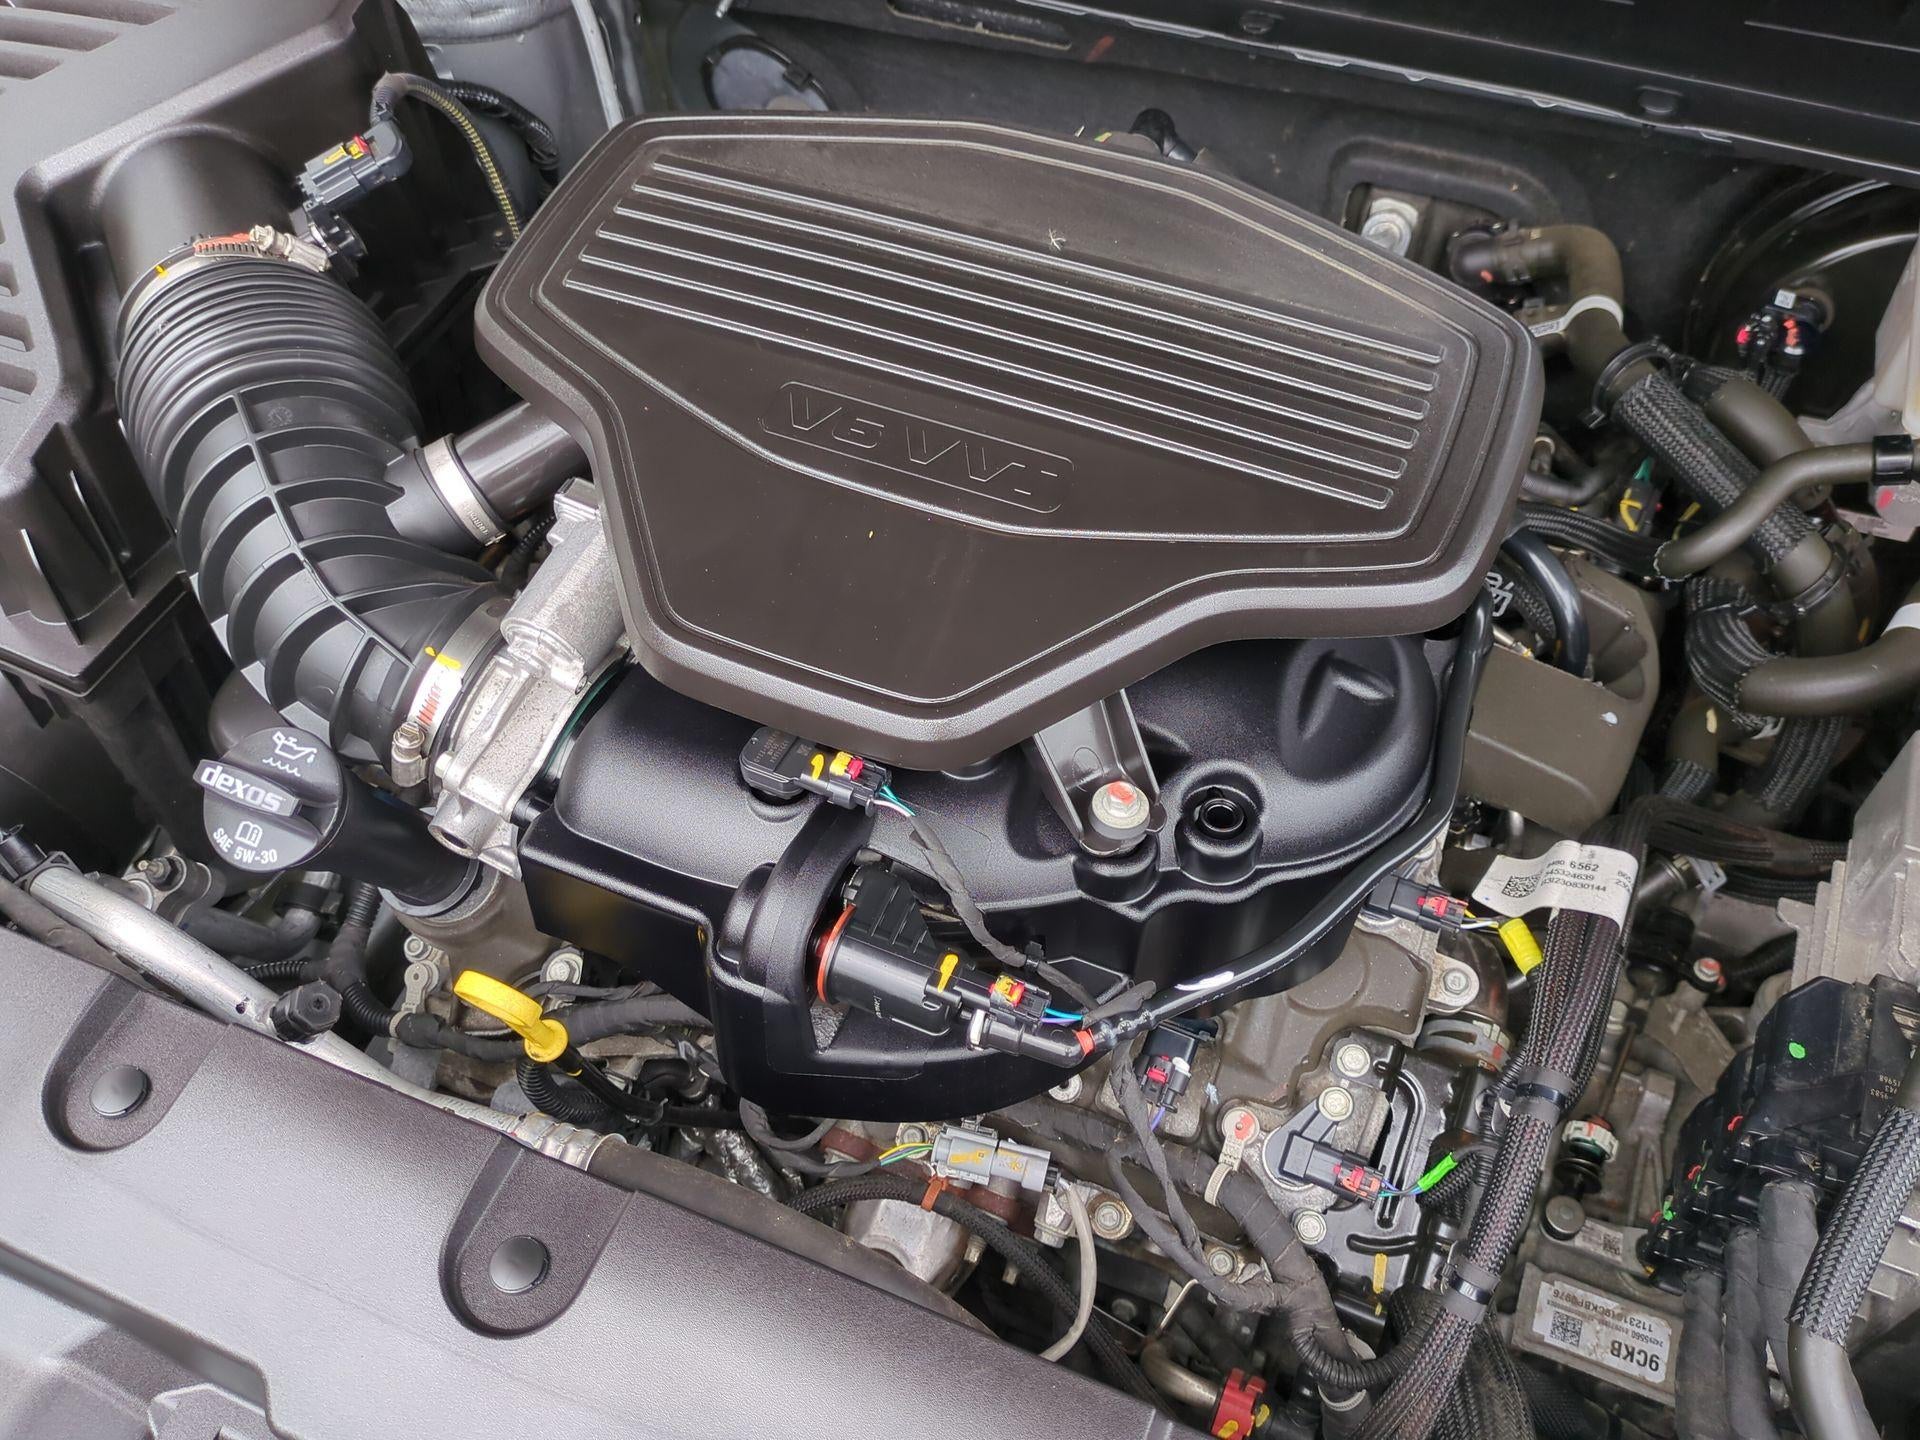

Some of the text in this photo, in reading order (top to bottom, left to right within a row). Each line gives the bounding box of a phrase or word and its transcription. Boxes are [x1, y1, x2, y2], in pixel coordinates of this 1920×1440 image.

[788, 391, 885, 450] V6
[200, 765, 284, 812] dexos
[213, 828, 278, 865] SAE 5W-30
[1569, 860, 1600, 872] 6562
[1610, 1339, 1660, 1372] 9CKB
